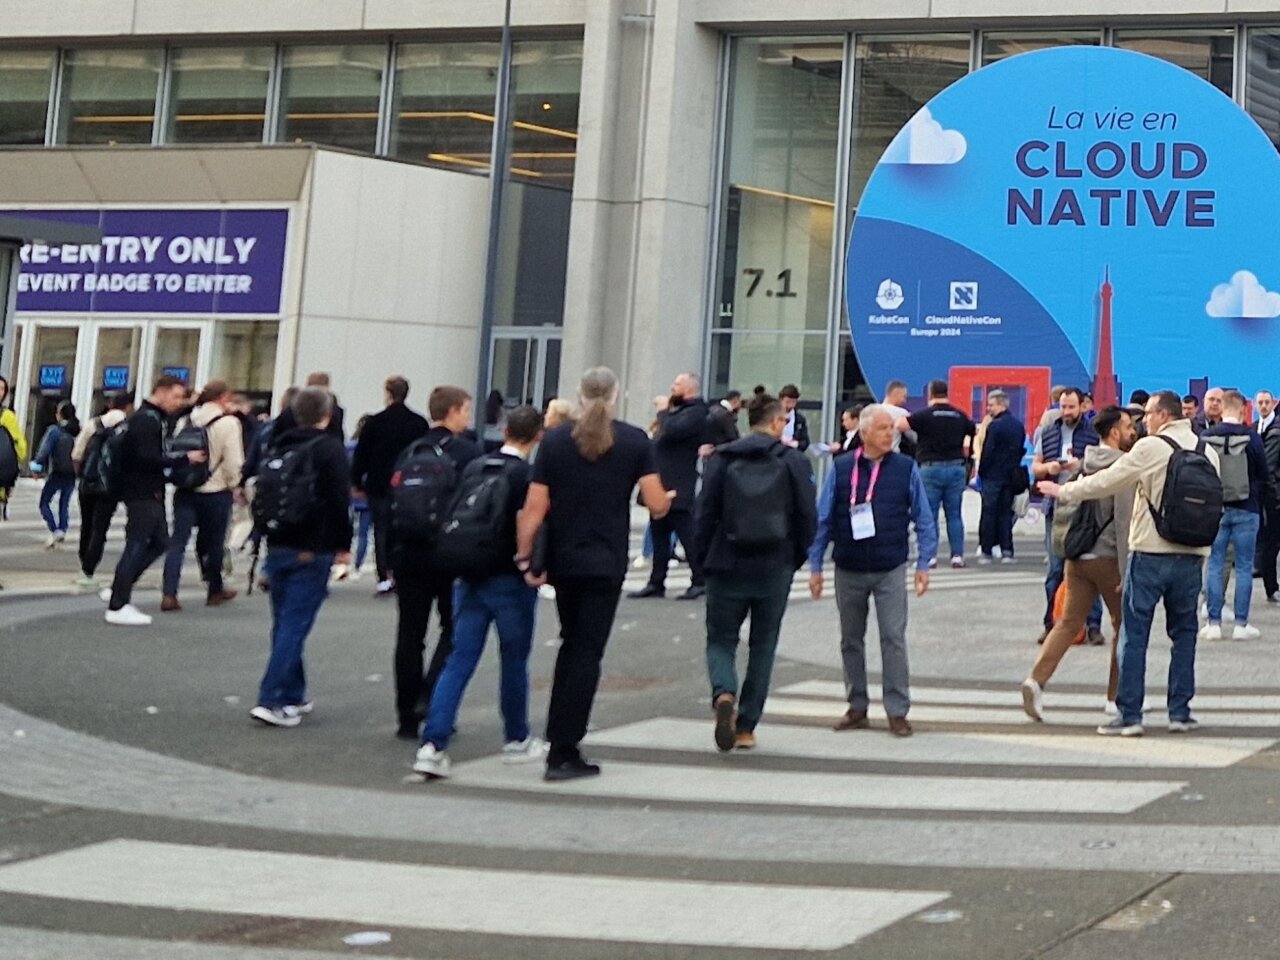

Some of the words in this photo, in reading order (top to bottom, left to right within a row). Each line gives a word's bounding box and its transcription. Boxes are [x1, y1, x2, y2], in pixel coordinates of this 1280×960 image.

[1048, 106, 1084, 130] La
[1095, 106, 1134, 130] vie
[1142, 112, 1177, 131] en
[1015, 140, 1208, 179] CLOUD
[1006, 188, 1216, 227] NATIVE
[168, 237, 257, 265] ONLY
[17, 273, 82, 293] EVENT
[84, 274, 151, 293] BADGE
[154, 274, 183, 293] TO
[185, 275, 253, 294] ENTER
[743, 268, 797, 298] 7.1
[868, 315, 910, 325] KubeCon
[910, 328, 939, 337] Europe
[940, 328, 961, 336] 2024
[925, 315, 1001, 325] CloudNativeCon
